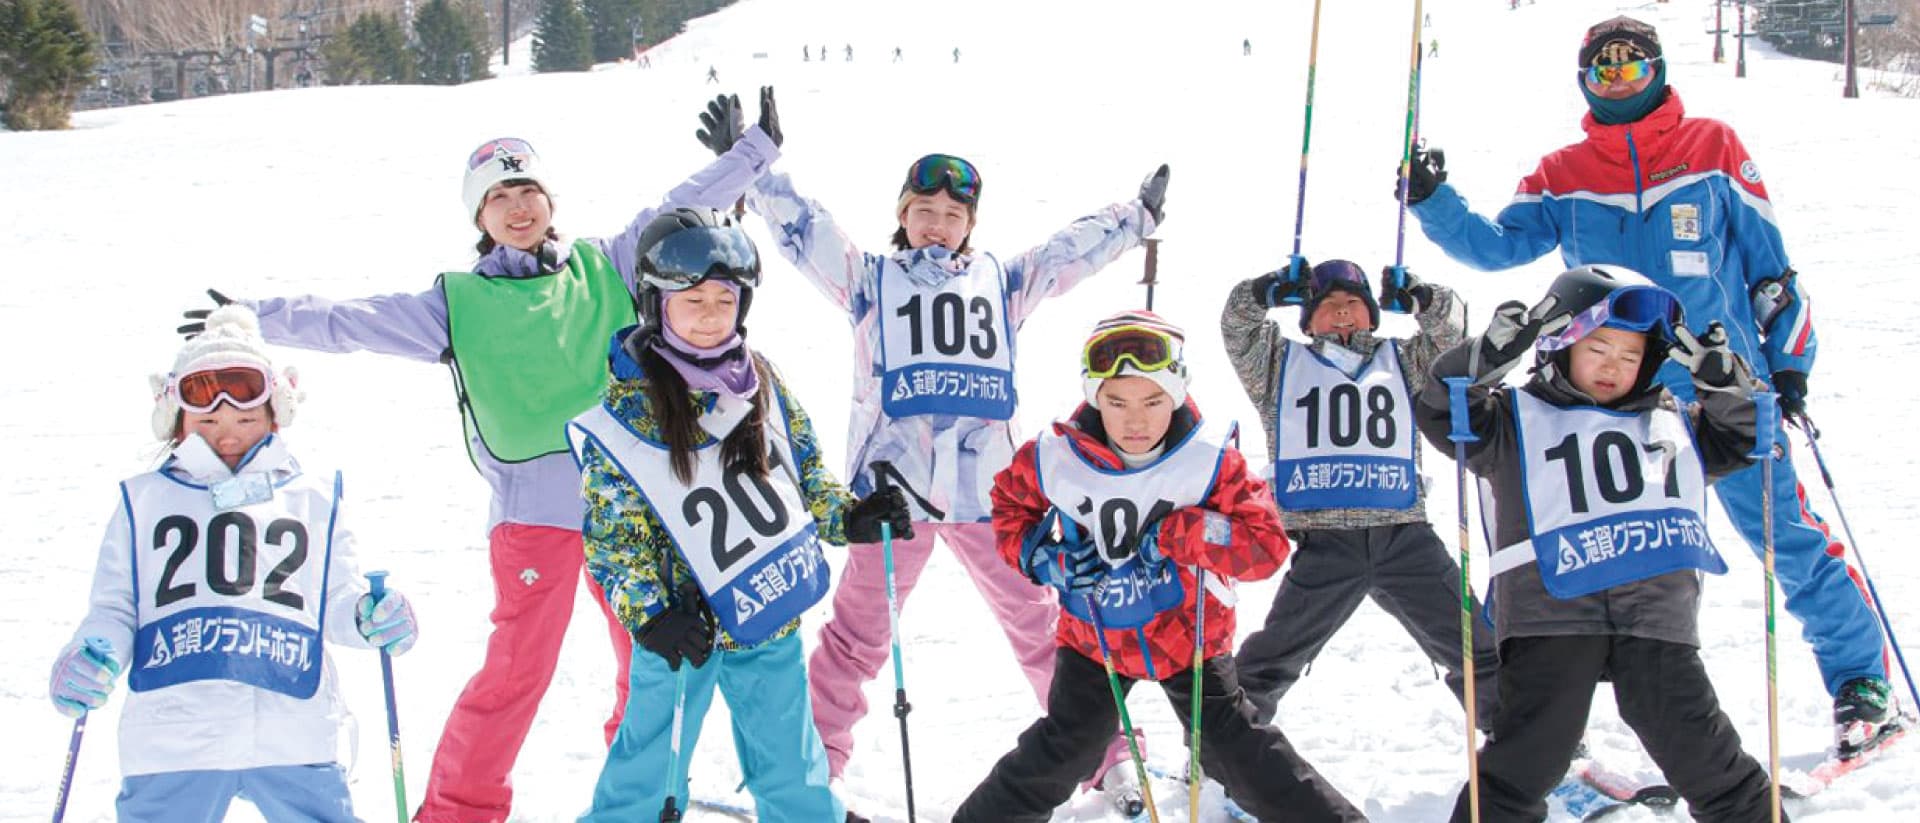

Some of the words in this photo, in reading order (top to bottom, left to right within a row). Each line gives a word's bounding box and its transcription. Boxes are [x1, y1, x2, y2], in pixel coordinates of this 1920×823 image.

[498, 156, 524, 173] NY
[896, 292, 997, 359] 103
[912, 369, 1008, 401] 志賀グランドホテル
[1296, 383, 1396, 448] 108
[1306, 462, 1410, 490] 志賀グランドホテル
[1544, 431, 1681, 513] 107
[153, 512, 309, 611] 202
[172, 617, 312, 671] 志賀グランドホテル
